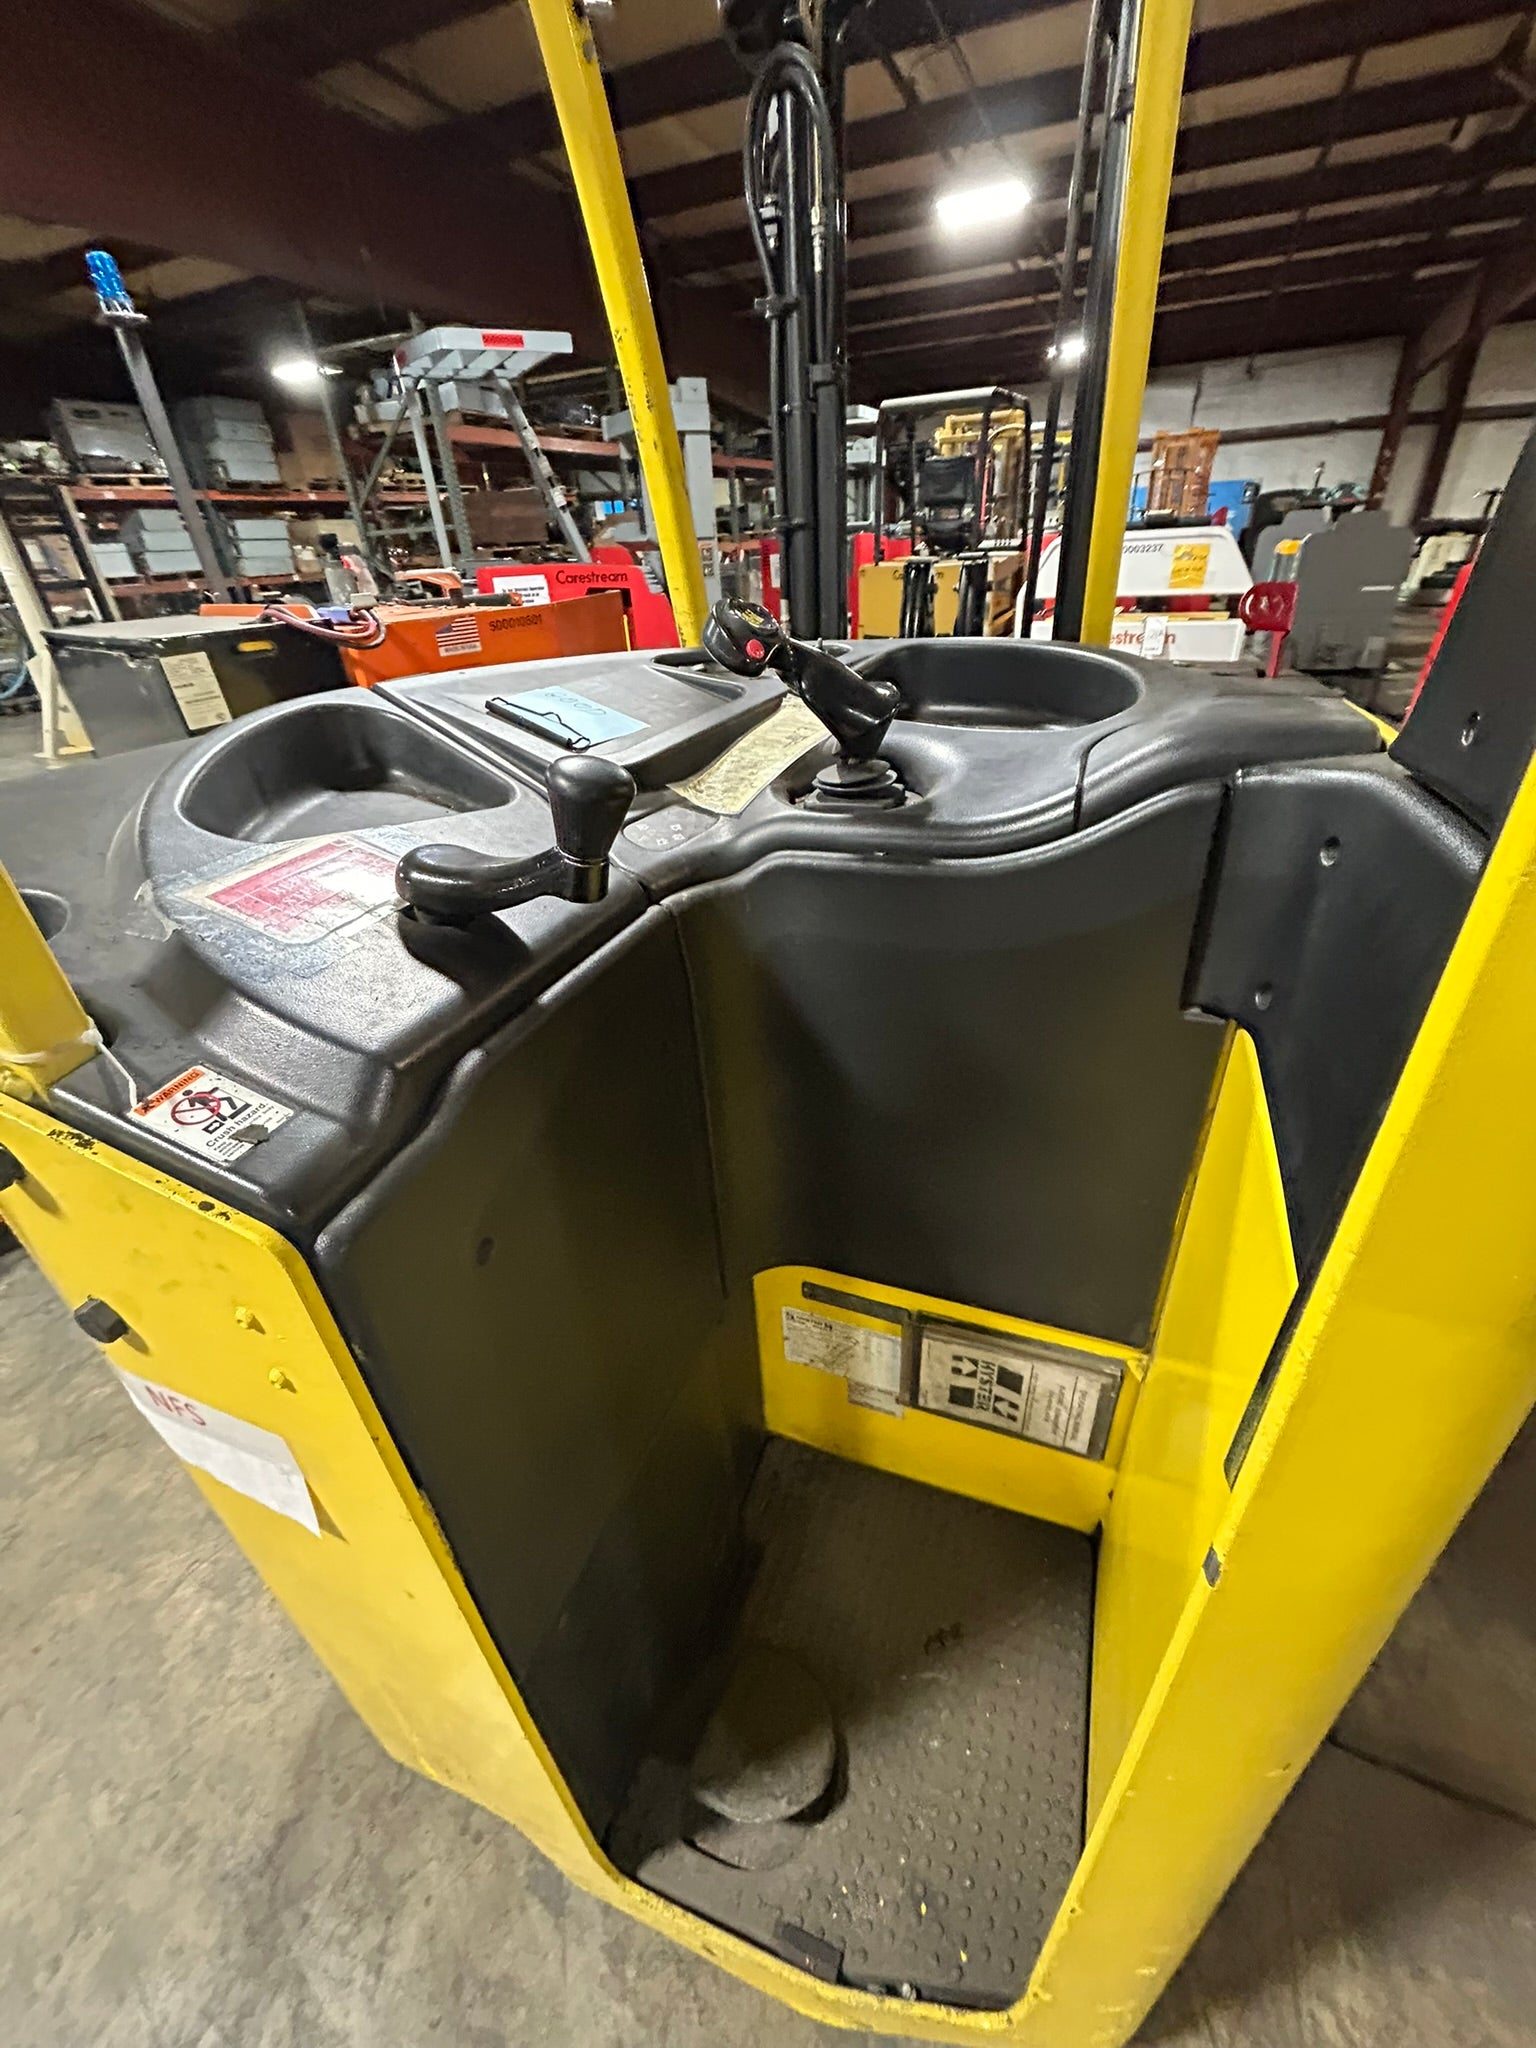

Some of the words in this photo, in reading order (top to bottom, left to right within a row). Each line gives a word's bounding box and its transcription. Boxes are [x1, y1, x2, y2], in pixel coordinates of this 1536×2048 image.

[555, 570, 628, 585] Carestream
[155, 1071, 200, 1103] WARNING
[206, 1125, 236, 1147] Crush
[234, 1102, 269, 1126] hazard.
[144, 1385, 207, 1427] NFS
[976, 1360, 996, 1411] HYSTER
